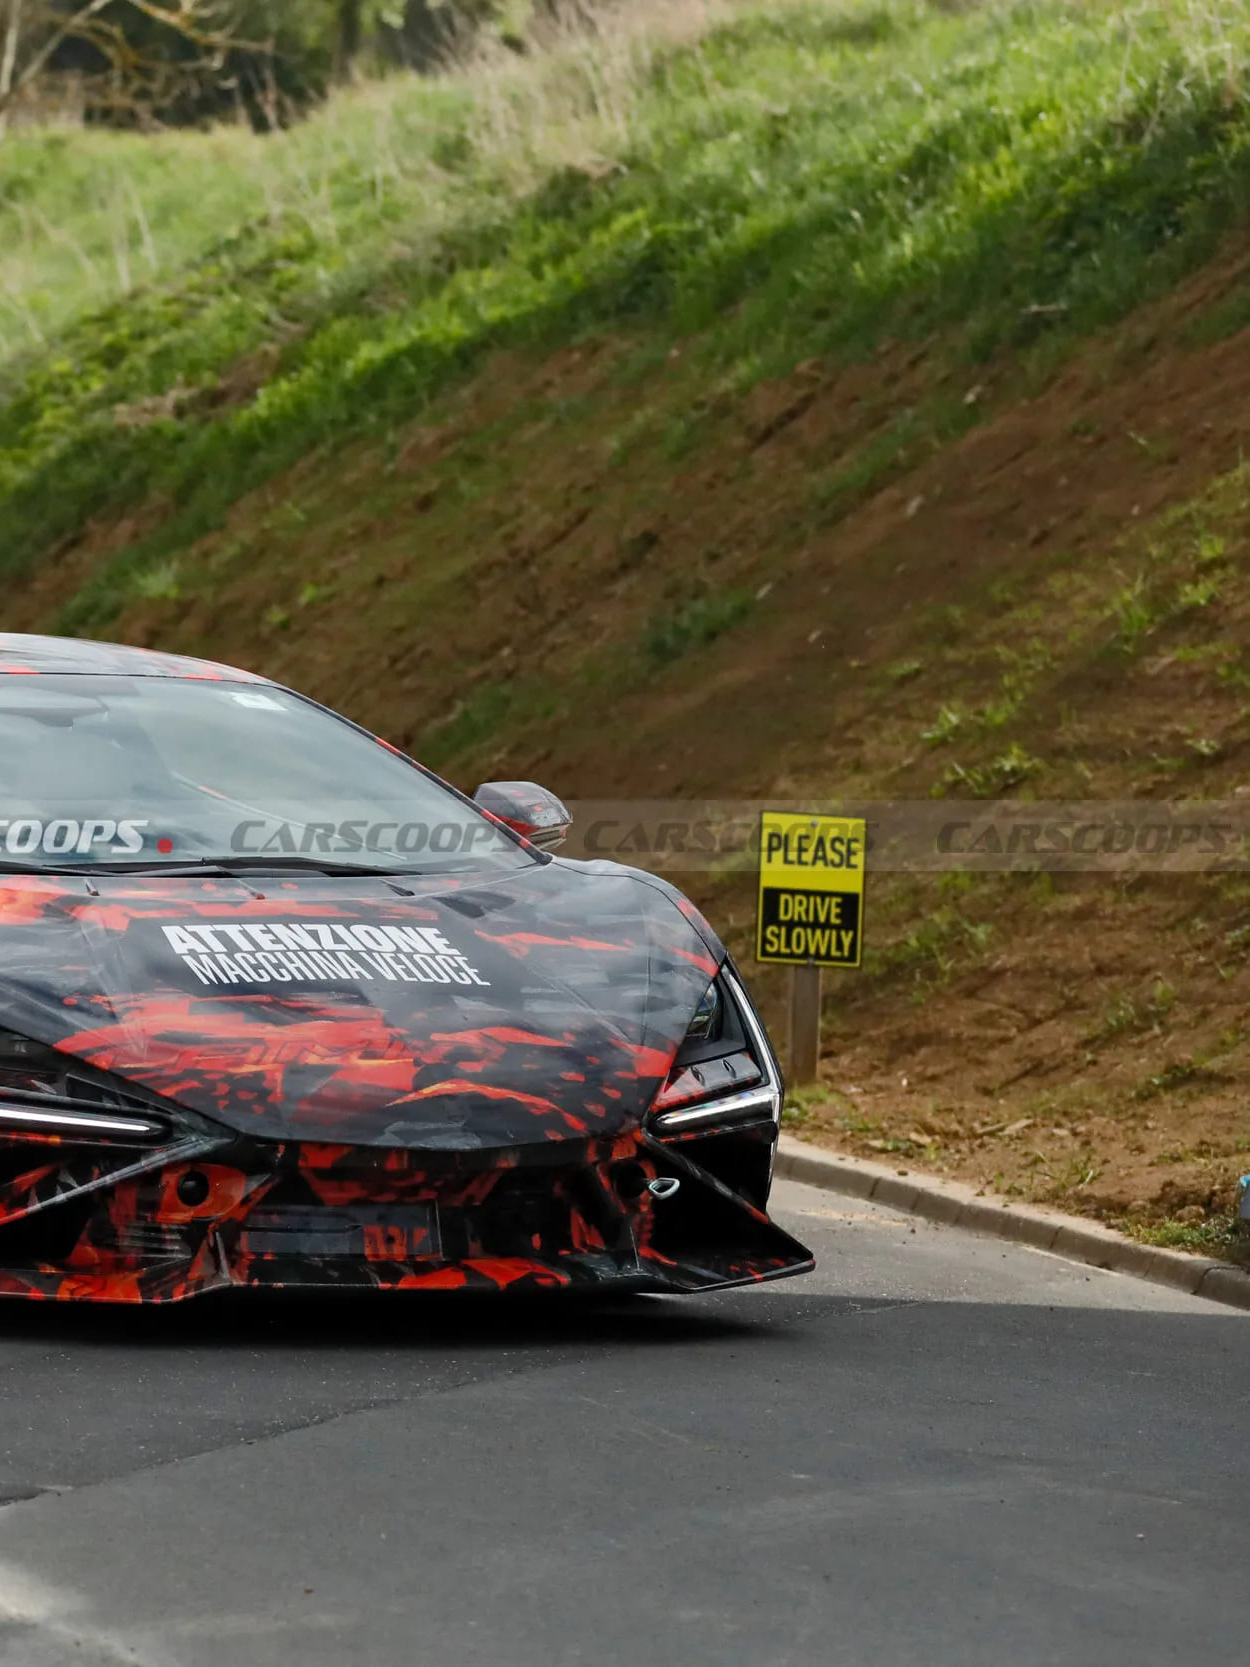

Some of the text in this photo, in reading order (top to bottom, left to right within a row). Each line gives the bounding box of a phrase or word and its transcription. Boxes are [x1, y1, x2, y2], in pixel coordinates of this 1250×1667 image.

[766, 832, 860, 869] PLEASE
[779, 893, 843, 925] DRIVE
[161, 923, 461, 956] ATTENZIONE
[765, 926, 854, 957] SLOWLY
[181, 951, 492, 986] MACCHINA VELOCE
